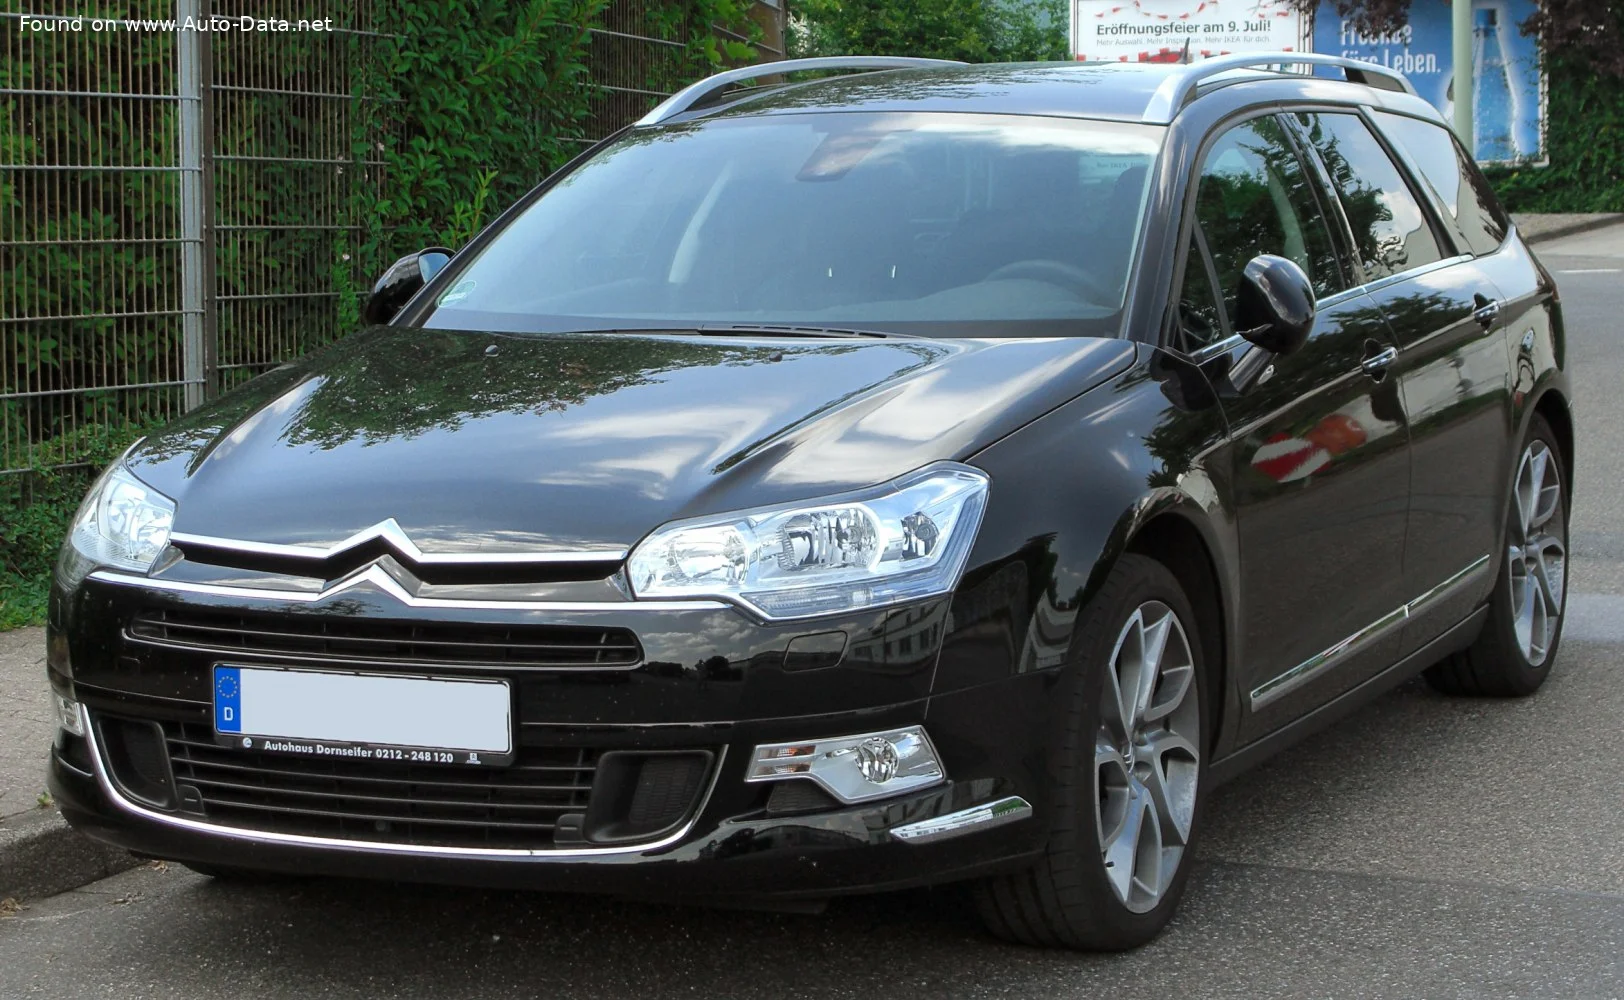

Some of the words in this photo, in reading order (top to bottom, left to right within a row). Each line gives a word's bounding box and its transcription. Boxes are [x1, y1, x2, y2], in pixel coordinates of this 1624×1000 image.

[1096, 21, 1200, 37] Eröffnungsfeier
[1203, 23, 1225, 33] am
[1228, 20, 1240, 33] 9.
[1243, 20, 1271, 33] Juli!
[1224, 35, 1241, 44] IKEA
[223, 706, 234, 722] D
[264, 740, 314, 754] Autohaus
[316, 744, 373, 758] Dornseifer
[375, 748, 403, 760] 0212
[411, 751, 432, 762] 248
[433, 752, 454, 763] 120
